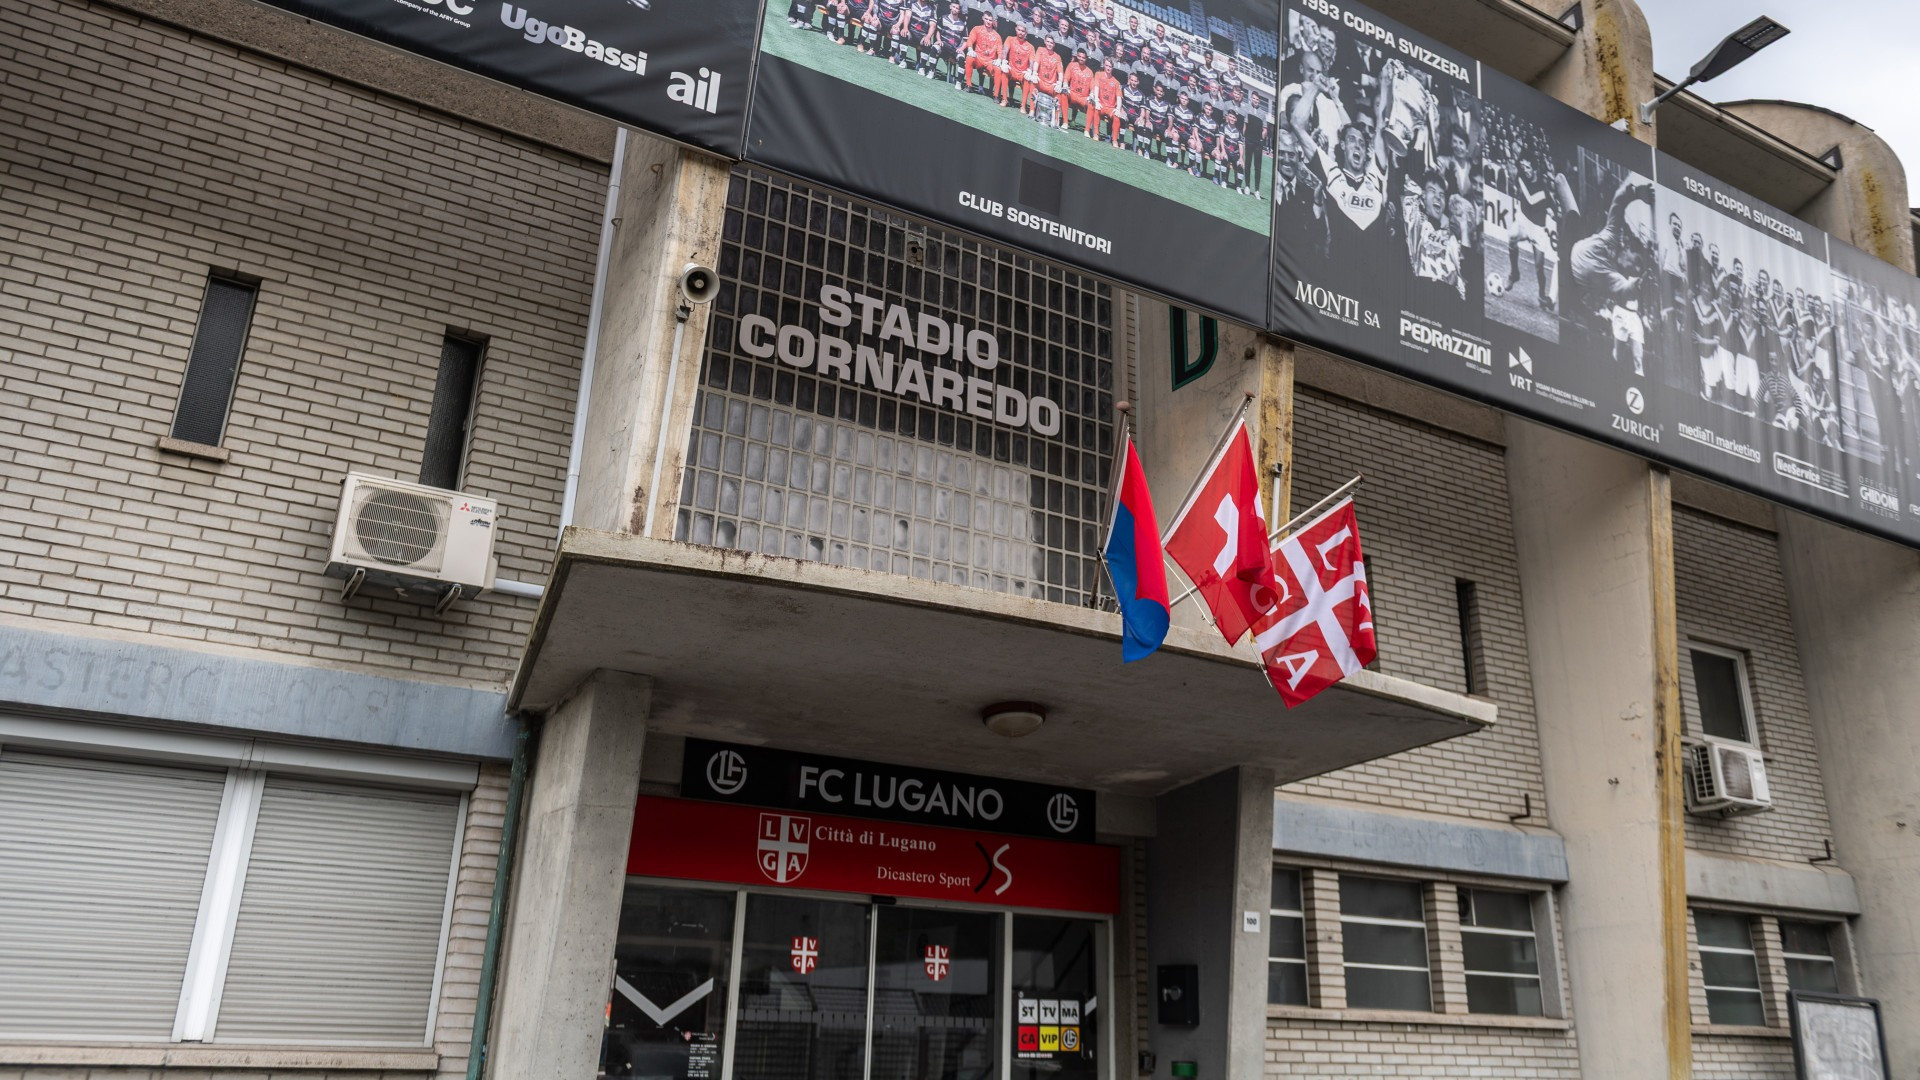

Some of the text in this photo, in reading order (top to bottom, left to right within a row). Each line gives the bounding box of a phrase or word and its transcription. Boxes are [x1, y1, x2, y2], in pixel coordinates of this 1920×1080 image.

[429, 9, 439, 17] the
[439, 13, 453, 22] AFRY
[453, 18, 471, 28] Group
[500, 2, 648, 76] UgoBassi
[1343, 11, 1396, 48] COPPA
[1398, 37, 1470, 84] SVIZZERA
[666, 67, 721, 114] ail
[958, 190, 1113, 255] CLUB SOSTENITORI
[1683, 176, 1804, 245] 1931 COPPA SVIZZERA
[1294, 280, 1381, 329] MONTI SA
[819, 284, 999, 370] STADIO
[1400, 317, 1491, 367] PEDRAZZINI
[739, 313, 1061, 436] CORNAREDO
[1508, 372, 1533, 392] VRT
[1715, 435, 1761, 463] marketing
[1776, 458, 1821, 484] NeoService
[1276, 649, 1319, 692] A
[798, 765, 1004, 821] FC LUGANO
[765, 820, 805, 841] L V
[815, 825, 937, 852] Città di Lugano
[762, 852, 801, 872] G A
[877, 866, 971, 888] Dicastero Sport
[1246, 917, 1258, 926] 100
[794, 938, 817, 950] L V
[793, 956, 815, 968] G A
[939, 964, 947, 975] A
[1022, 1006, 1035, 1017] ST
[1042, 1007, 1057, 1018] TV
[1061, 1008, 1078, 1018] MA
[1021, 1033, 1036, 1045] CA
[1041, 1034, 1058, 1044] VIP
